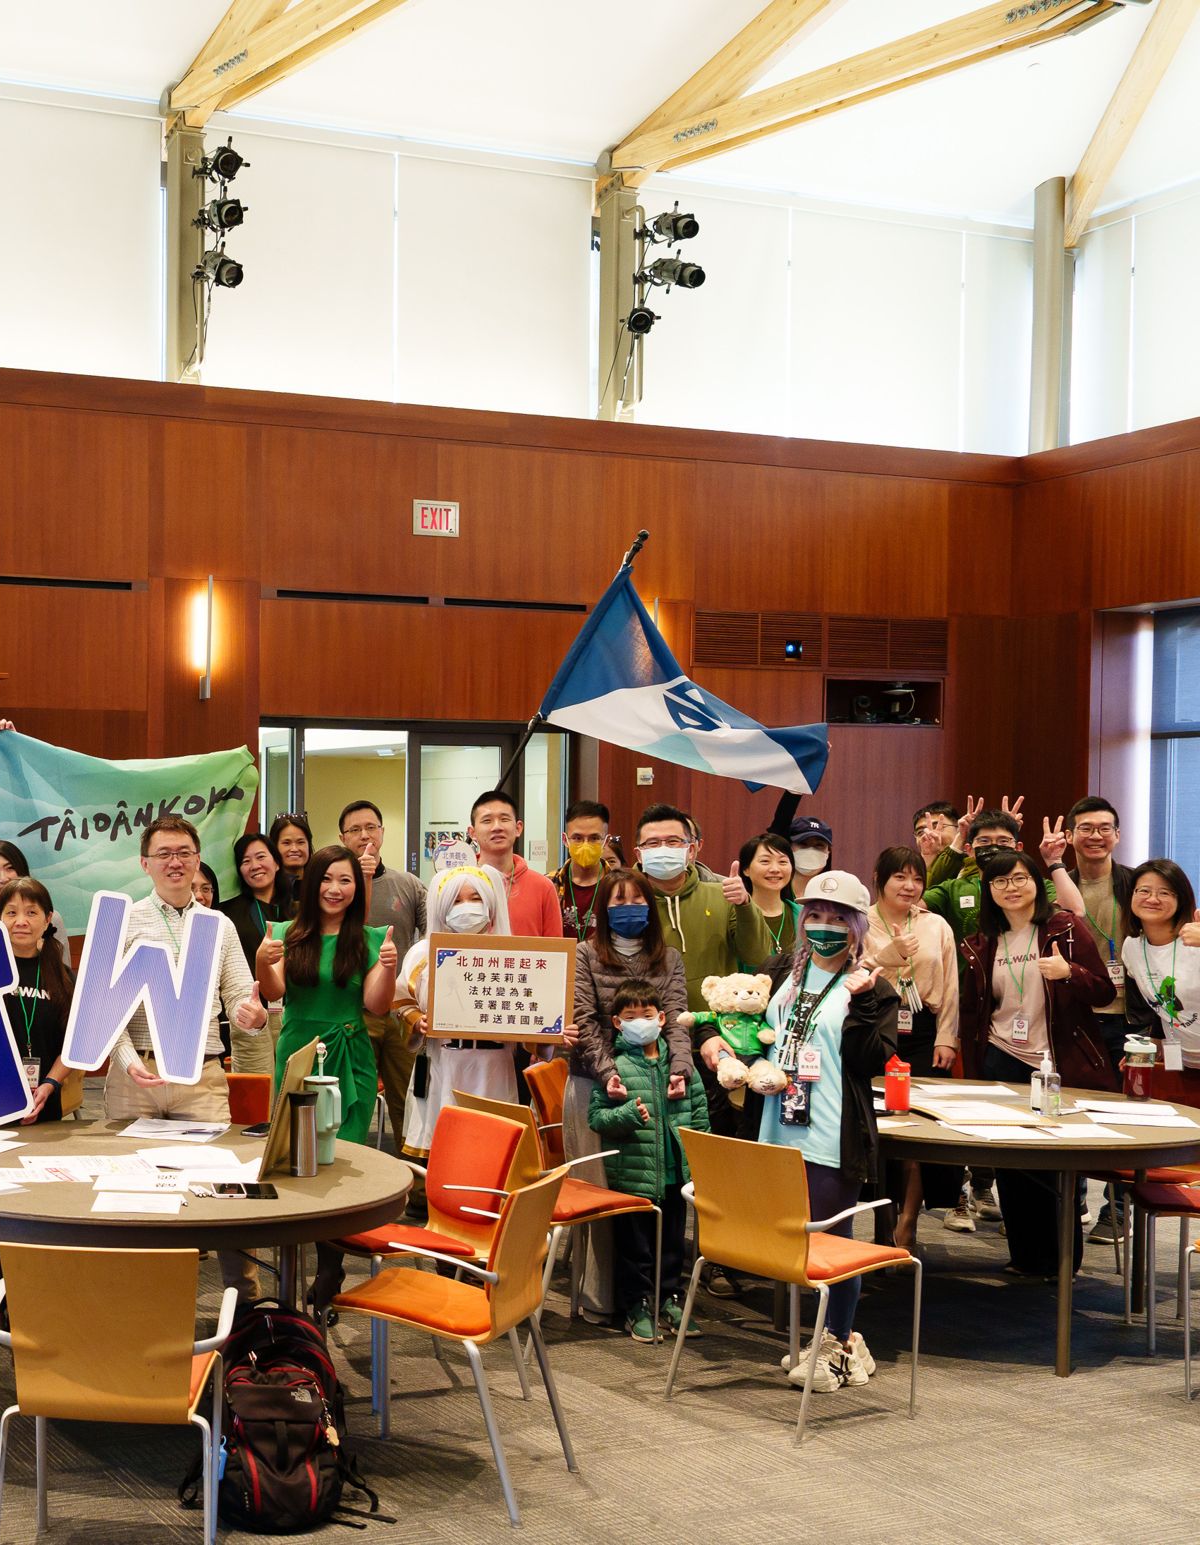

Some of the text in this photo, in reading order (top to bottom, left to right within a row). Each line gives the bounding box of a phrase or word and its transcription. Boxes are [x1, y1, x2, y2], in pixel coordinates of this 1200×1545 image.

[421, 507, 451, 530] EXIT
[456, 956, 547, 970] 北加州罷起來
[463, 971, 528, 983] 化身芙莉蓮
[468, 985, 533, 998] 法杖變為筆
[473, 1000, 538, 1012] 簽署罷免書
[479, 1013, 544, 1026] 葬送賣國賊
